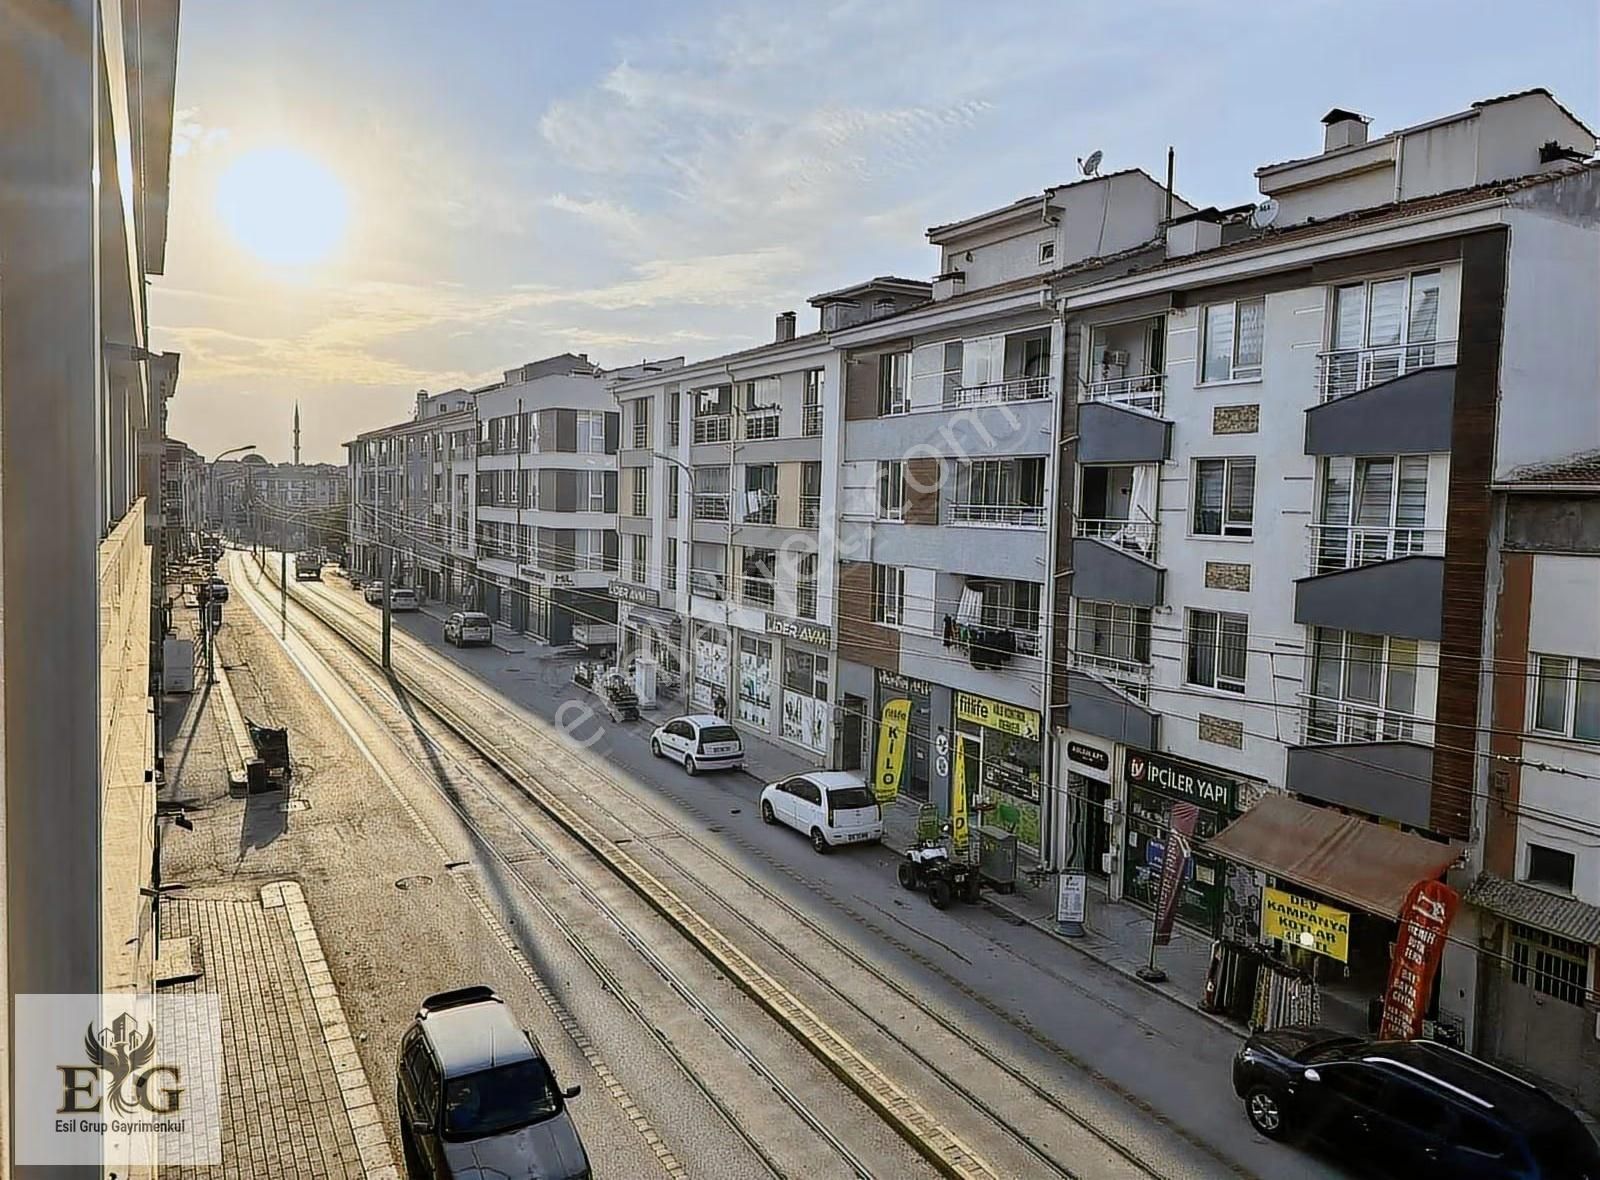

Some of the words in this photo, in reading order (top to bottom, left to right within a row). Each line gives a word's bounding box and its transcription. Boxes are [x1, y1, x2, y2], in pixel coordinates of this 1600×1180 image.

[1148, 761, 1194, 795] İPÇİLER
[1197, 779, 1227, 805] YAPI
[1267, 900, 1347, 934] KAMPANYA
[1290, 895, 1318, 912] DEV
